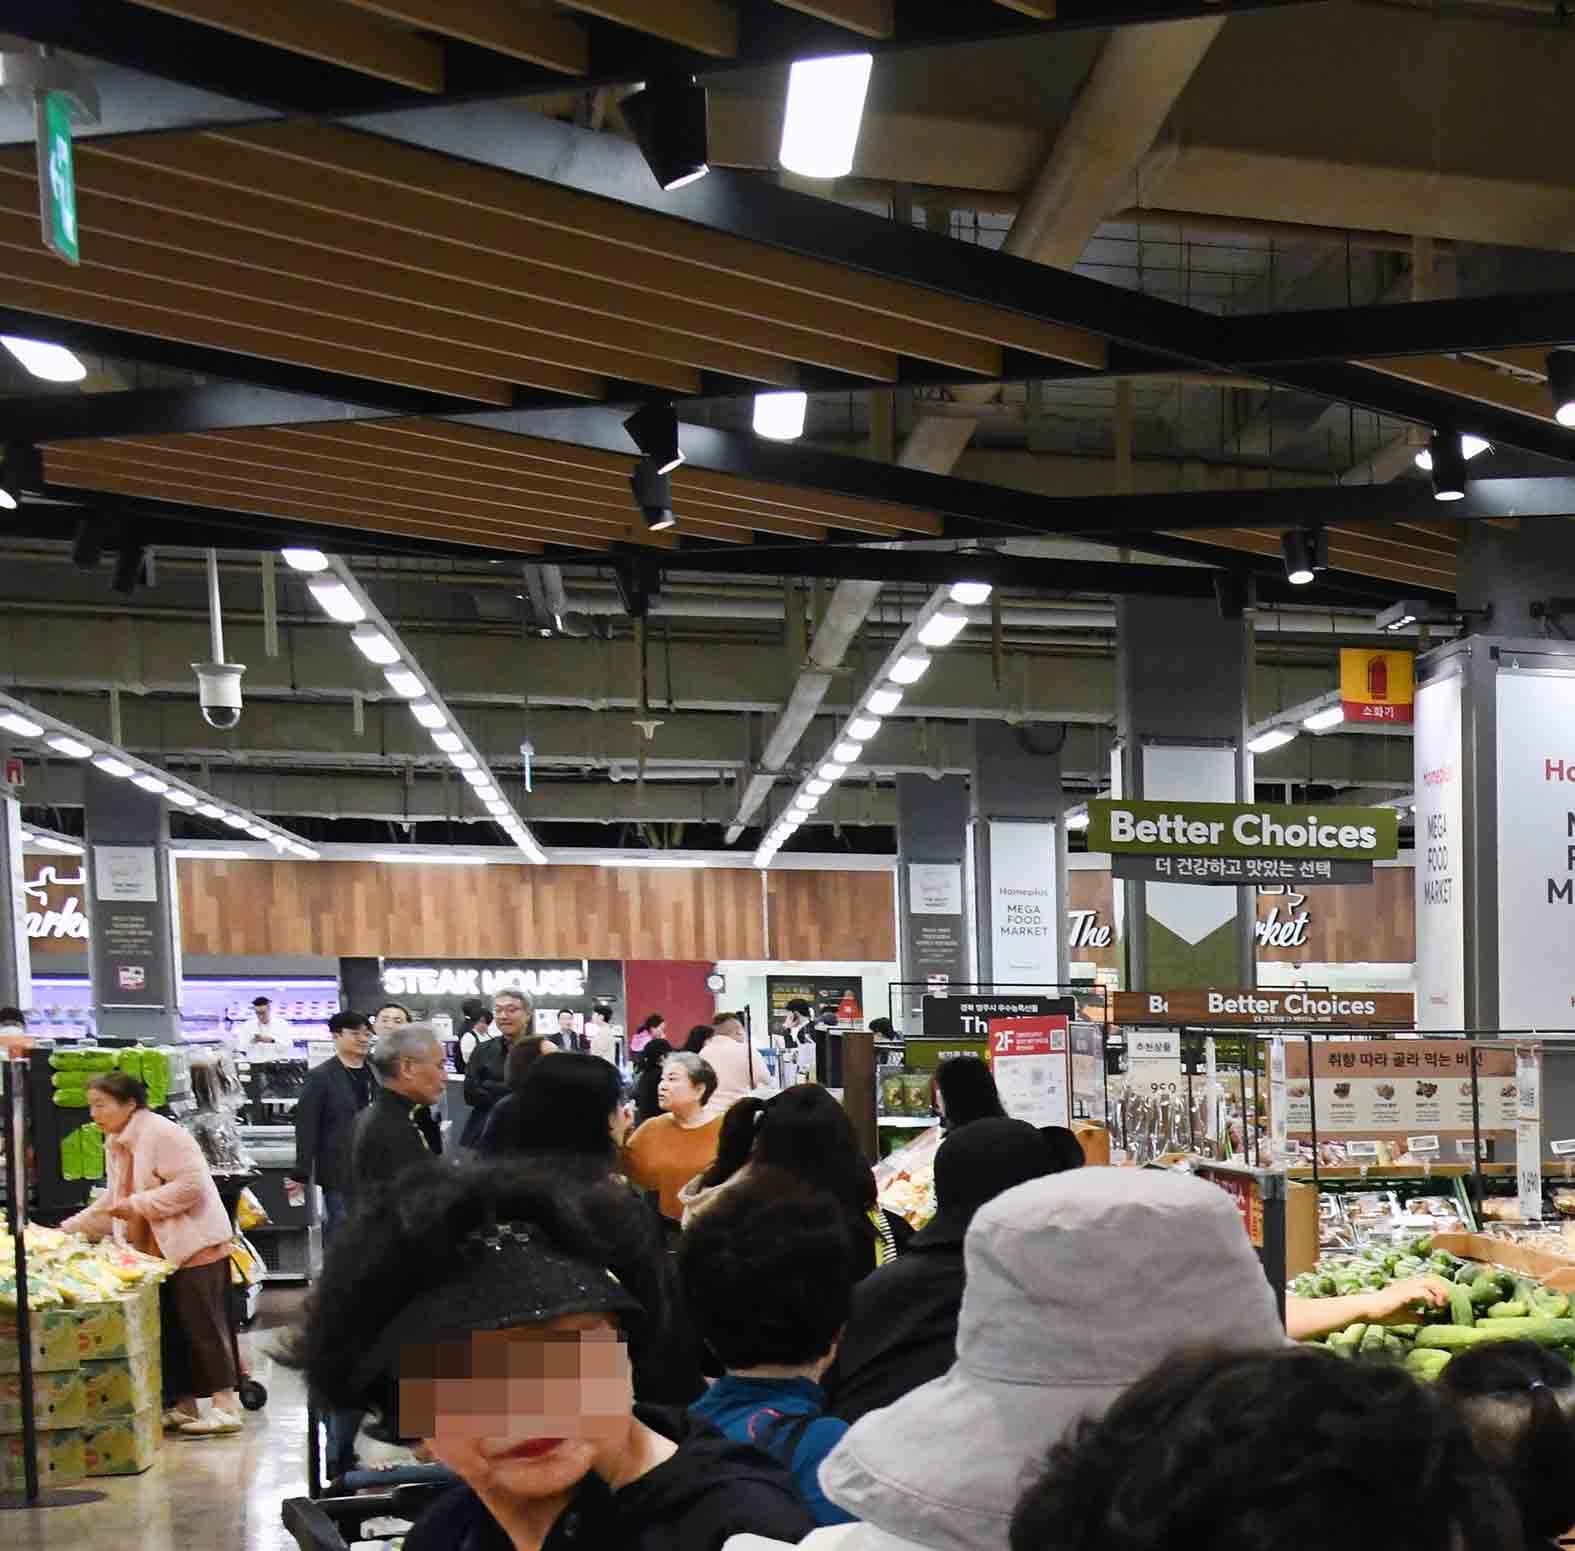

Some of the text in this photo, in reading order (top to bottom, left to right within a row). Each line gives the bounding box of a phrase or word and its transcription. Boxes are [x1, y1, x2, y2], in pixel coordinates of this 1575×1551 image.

[1109, 810, 1378, 850] Better Choices
[1426, 813, 1448, 841] MEGA
[1155, 858, 1332, 879] 더 건강하고 맛있는 선택
[1427, 846, 1449, 873] FOOD
[1424, 877, 1453, 906] MARKET
[1007, 904, 1041, 914] MEGA
[1007, 915, 1041, 925] FOOD
[1000, 926, 1049, 937] MARKET
[1067, 910, 1111, 948] The
[383, 967, 585, 996] STEAK HOUSE
[1208, 992, 1376, 1016] Better Choices
[993, 1030, 1015, 1052] 2F
[1359, 1051, 1388, 1067] 따라
